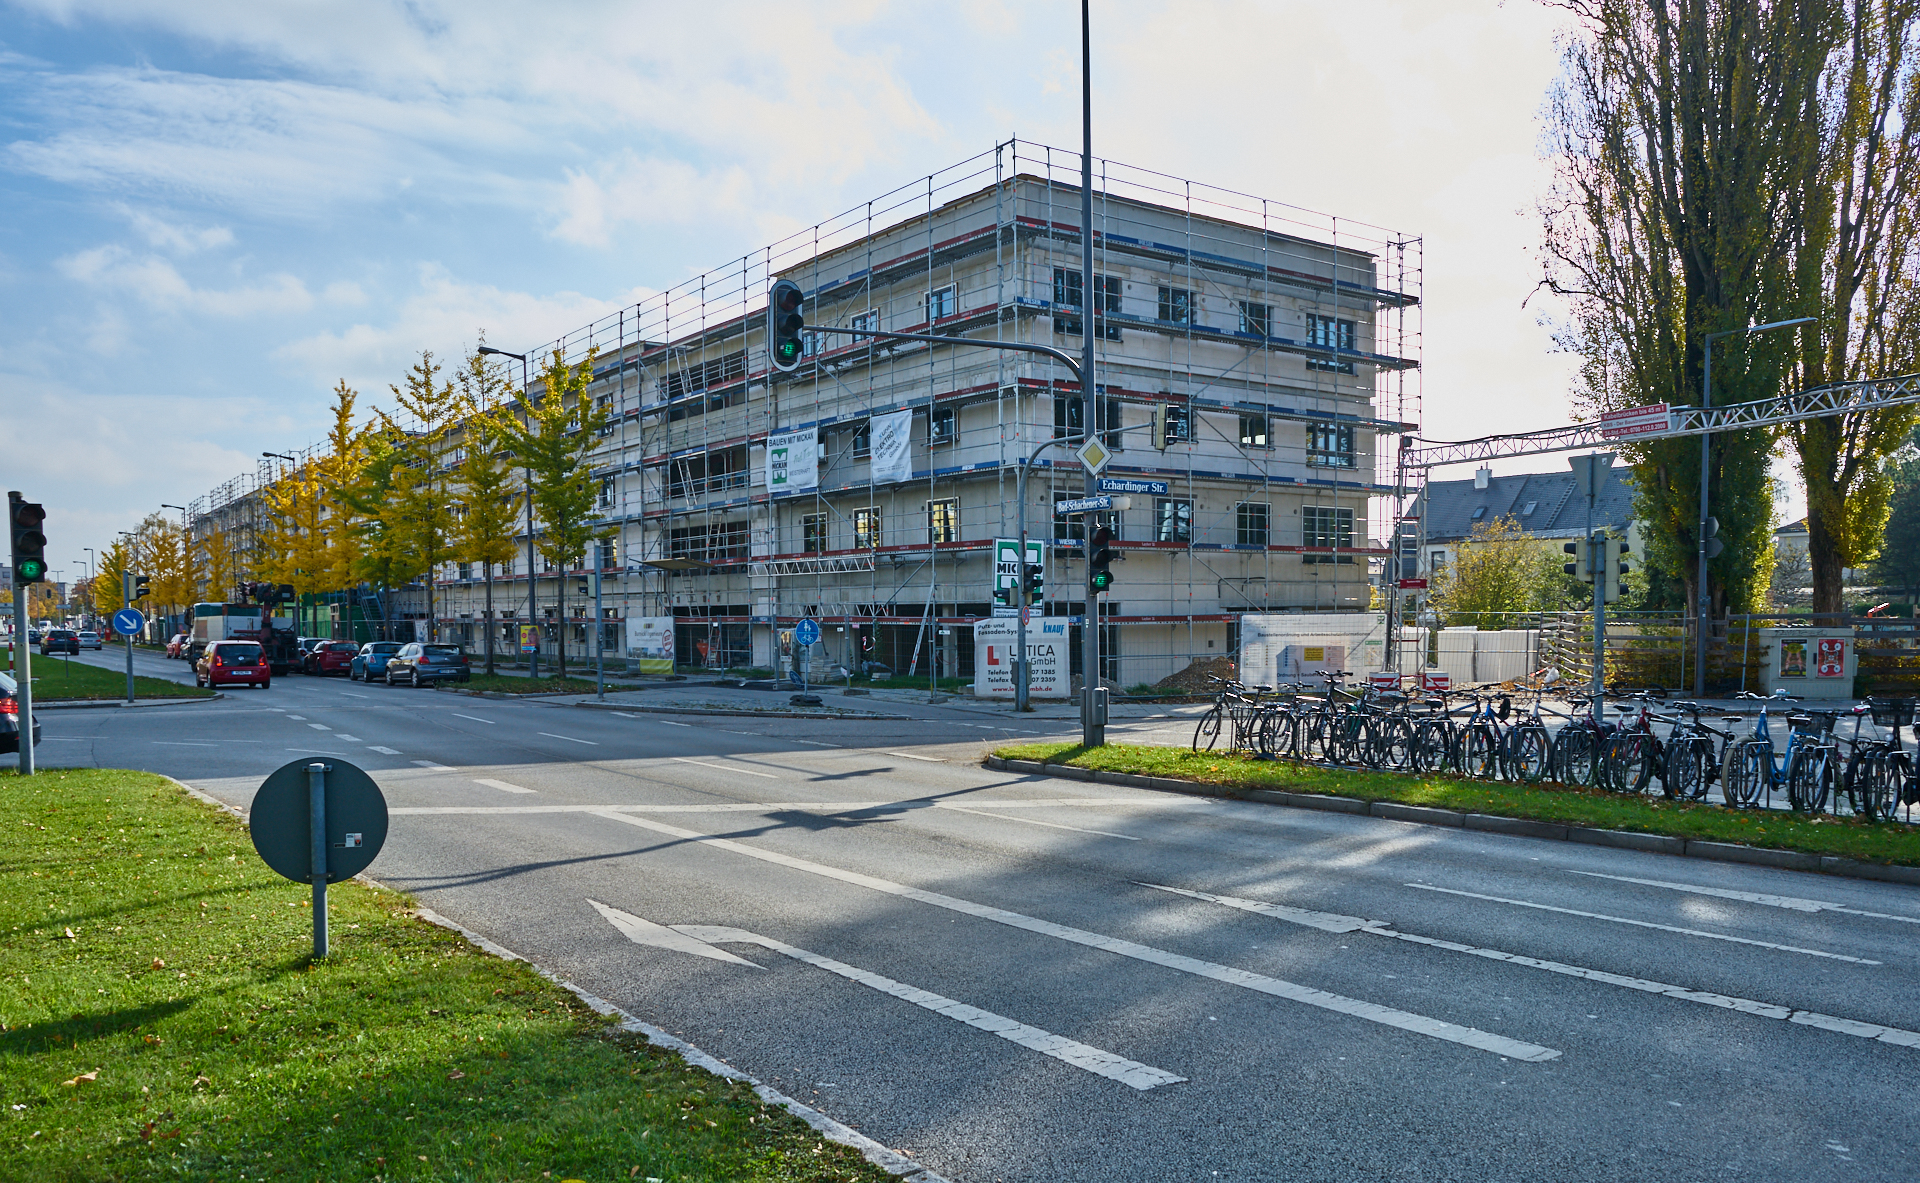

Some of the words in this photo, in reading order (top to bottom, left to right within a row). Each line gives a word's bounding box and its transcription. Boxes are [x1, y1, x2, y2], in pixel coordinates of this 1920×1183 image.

[1604, 411, 1638, 420] Kabelbrücken
[769, 437, 787, 446] BAUEN
[788, 435, 796, 444] MIT
[797, 432, 814, 442] MICKAN
[875, 430, 894, 454] ELEKTRO
[1103, 480, 1149, 493] Echardinger
[1152, 483, 1164, 493] Str.
[1010, 645, 1055, 656] LTICA
